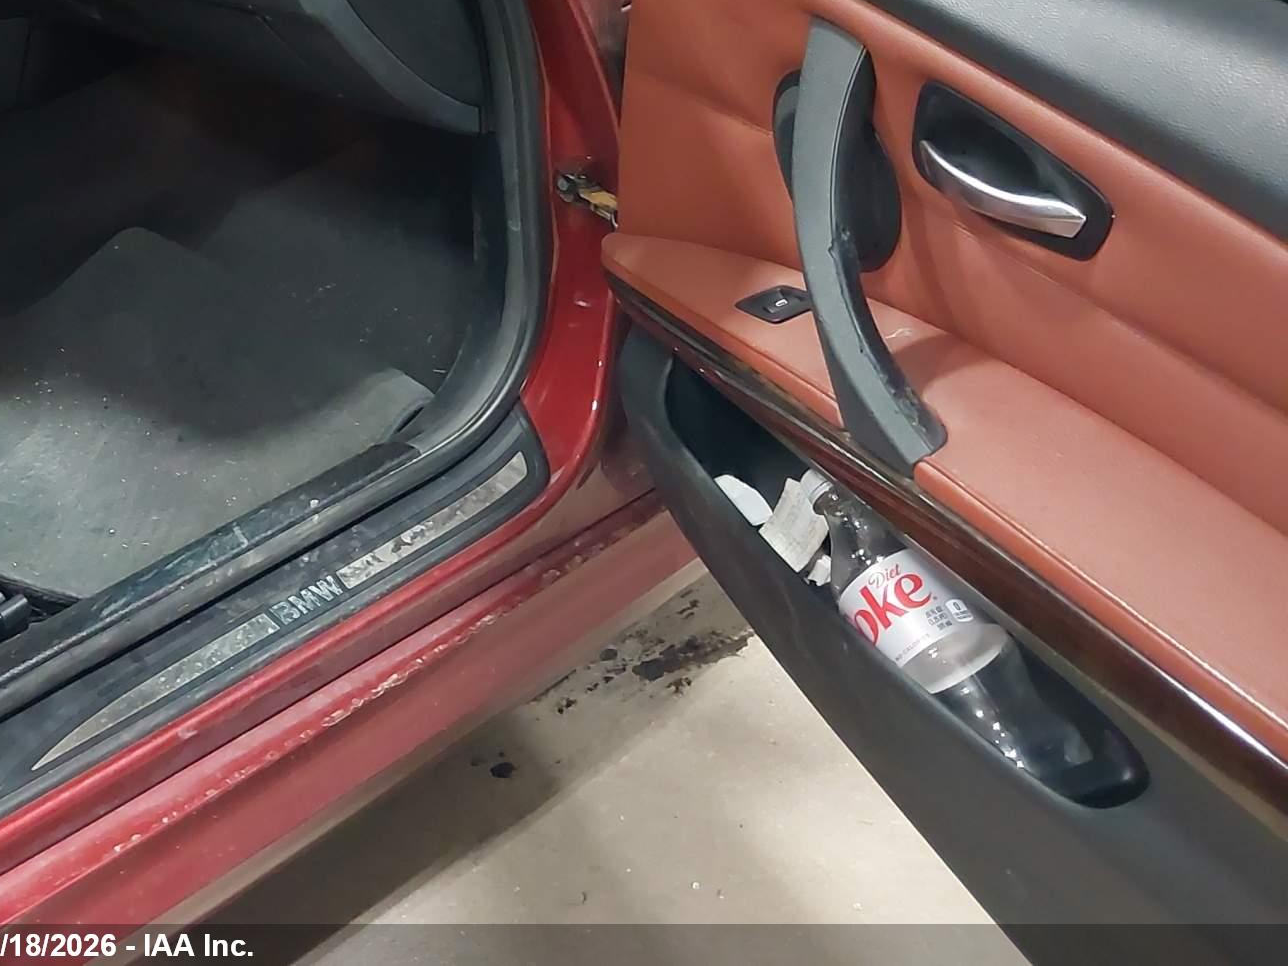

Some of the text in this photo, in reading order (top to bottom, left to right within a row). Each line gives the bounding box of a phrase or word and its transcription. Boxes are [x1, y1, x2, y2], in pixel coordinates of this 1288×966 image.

[268, 575, 344, 626] BMW
[867, 563, 902, 589] Diet
[844, 572, 933, 648] oke
